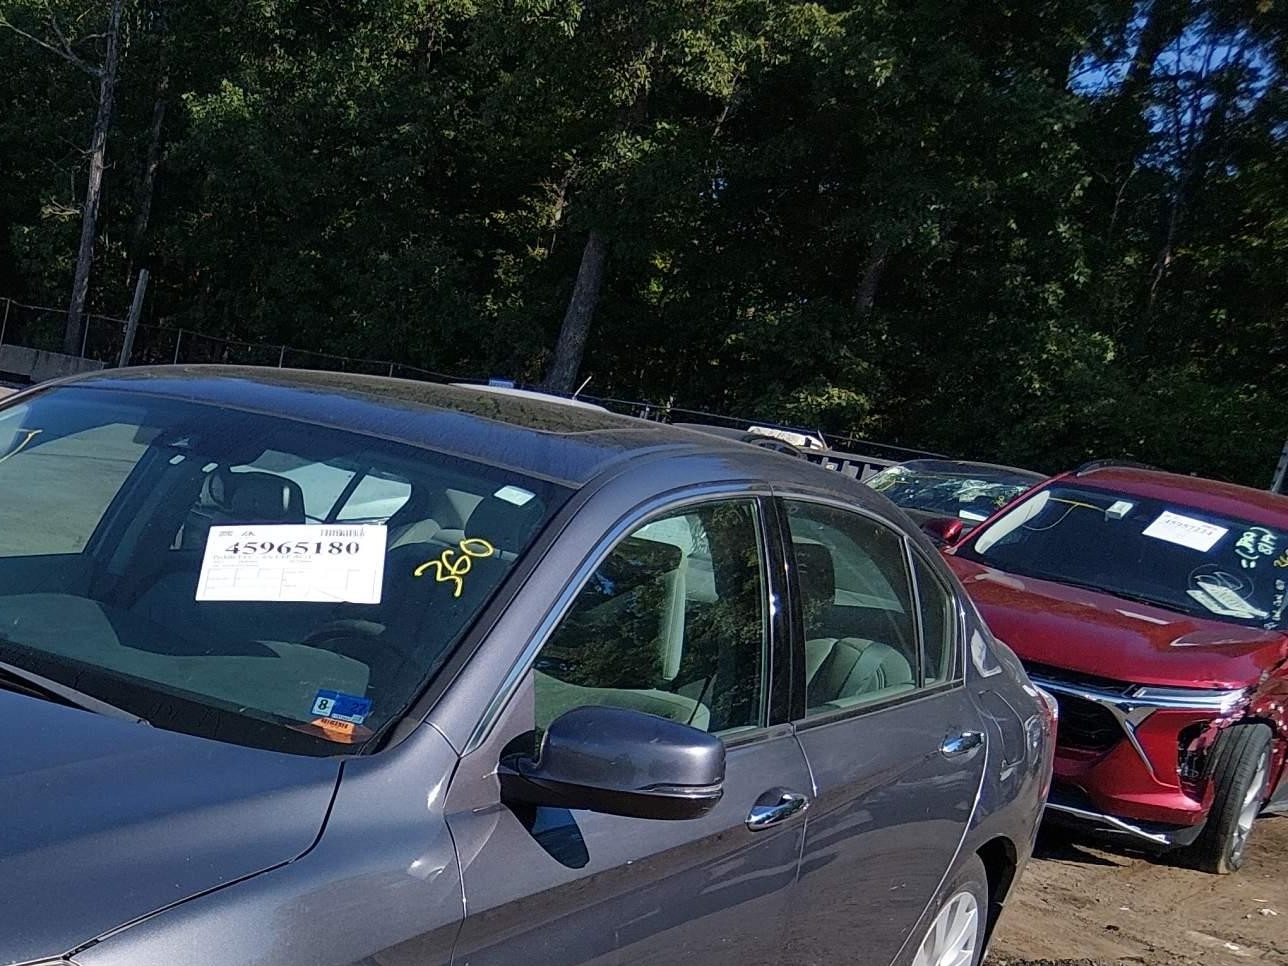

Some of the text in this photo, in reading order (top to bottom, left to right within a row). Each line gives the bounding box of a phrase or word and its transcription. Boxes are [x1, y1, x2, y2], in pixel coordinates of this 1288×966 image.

[225, 541, 360, 555] 45965180
[414, 538, 494, 597] 360
[318, 699, 329, 711] 8
